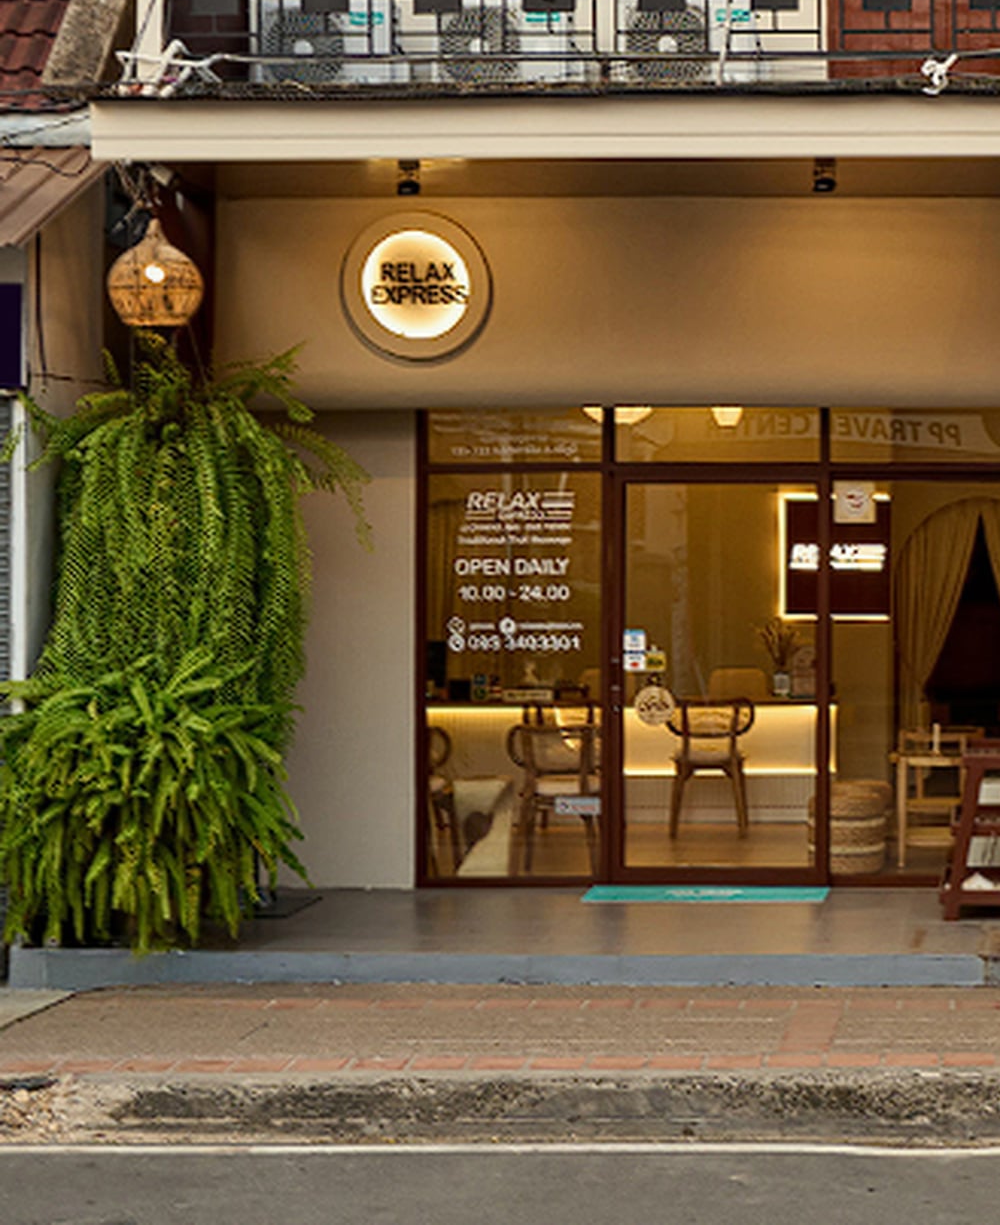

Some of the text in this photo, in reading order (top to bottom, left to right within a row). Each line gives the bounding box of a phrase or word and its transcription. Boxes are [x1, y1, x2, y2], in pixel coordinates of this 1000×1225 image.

[380, 262, 457, 283] RELAX
[370, 285, 469, 305] EXPRESS
[466, 491, 541, 510] RELAX
[454, 558, 570, 576] OPEN DAILY
